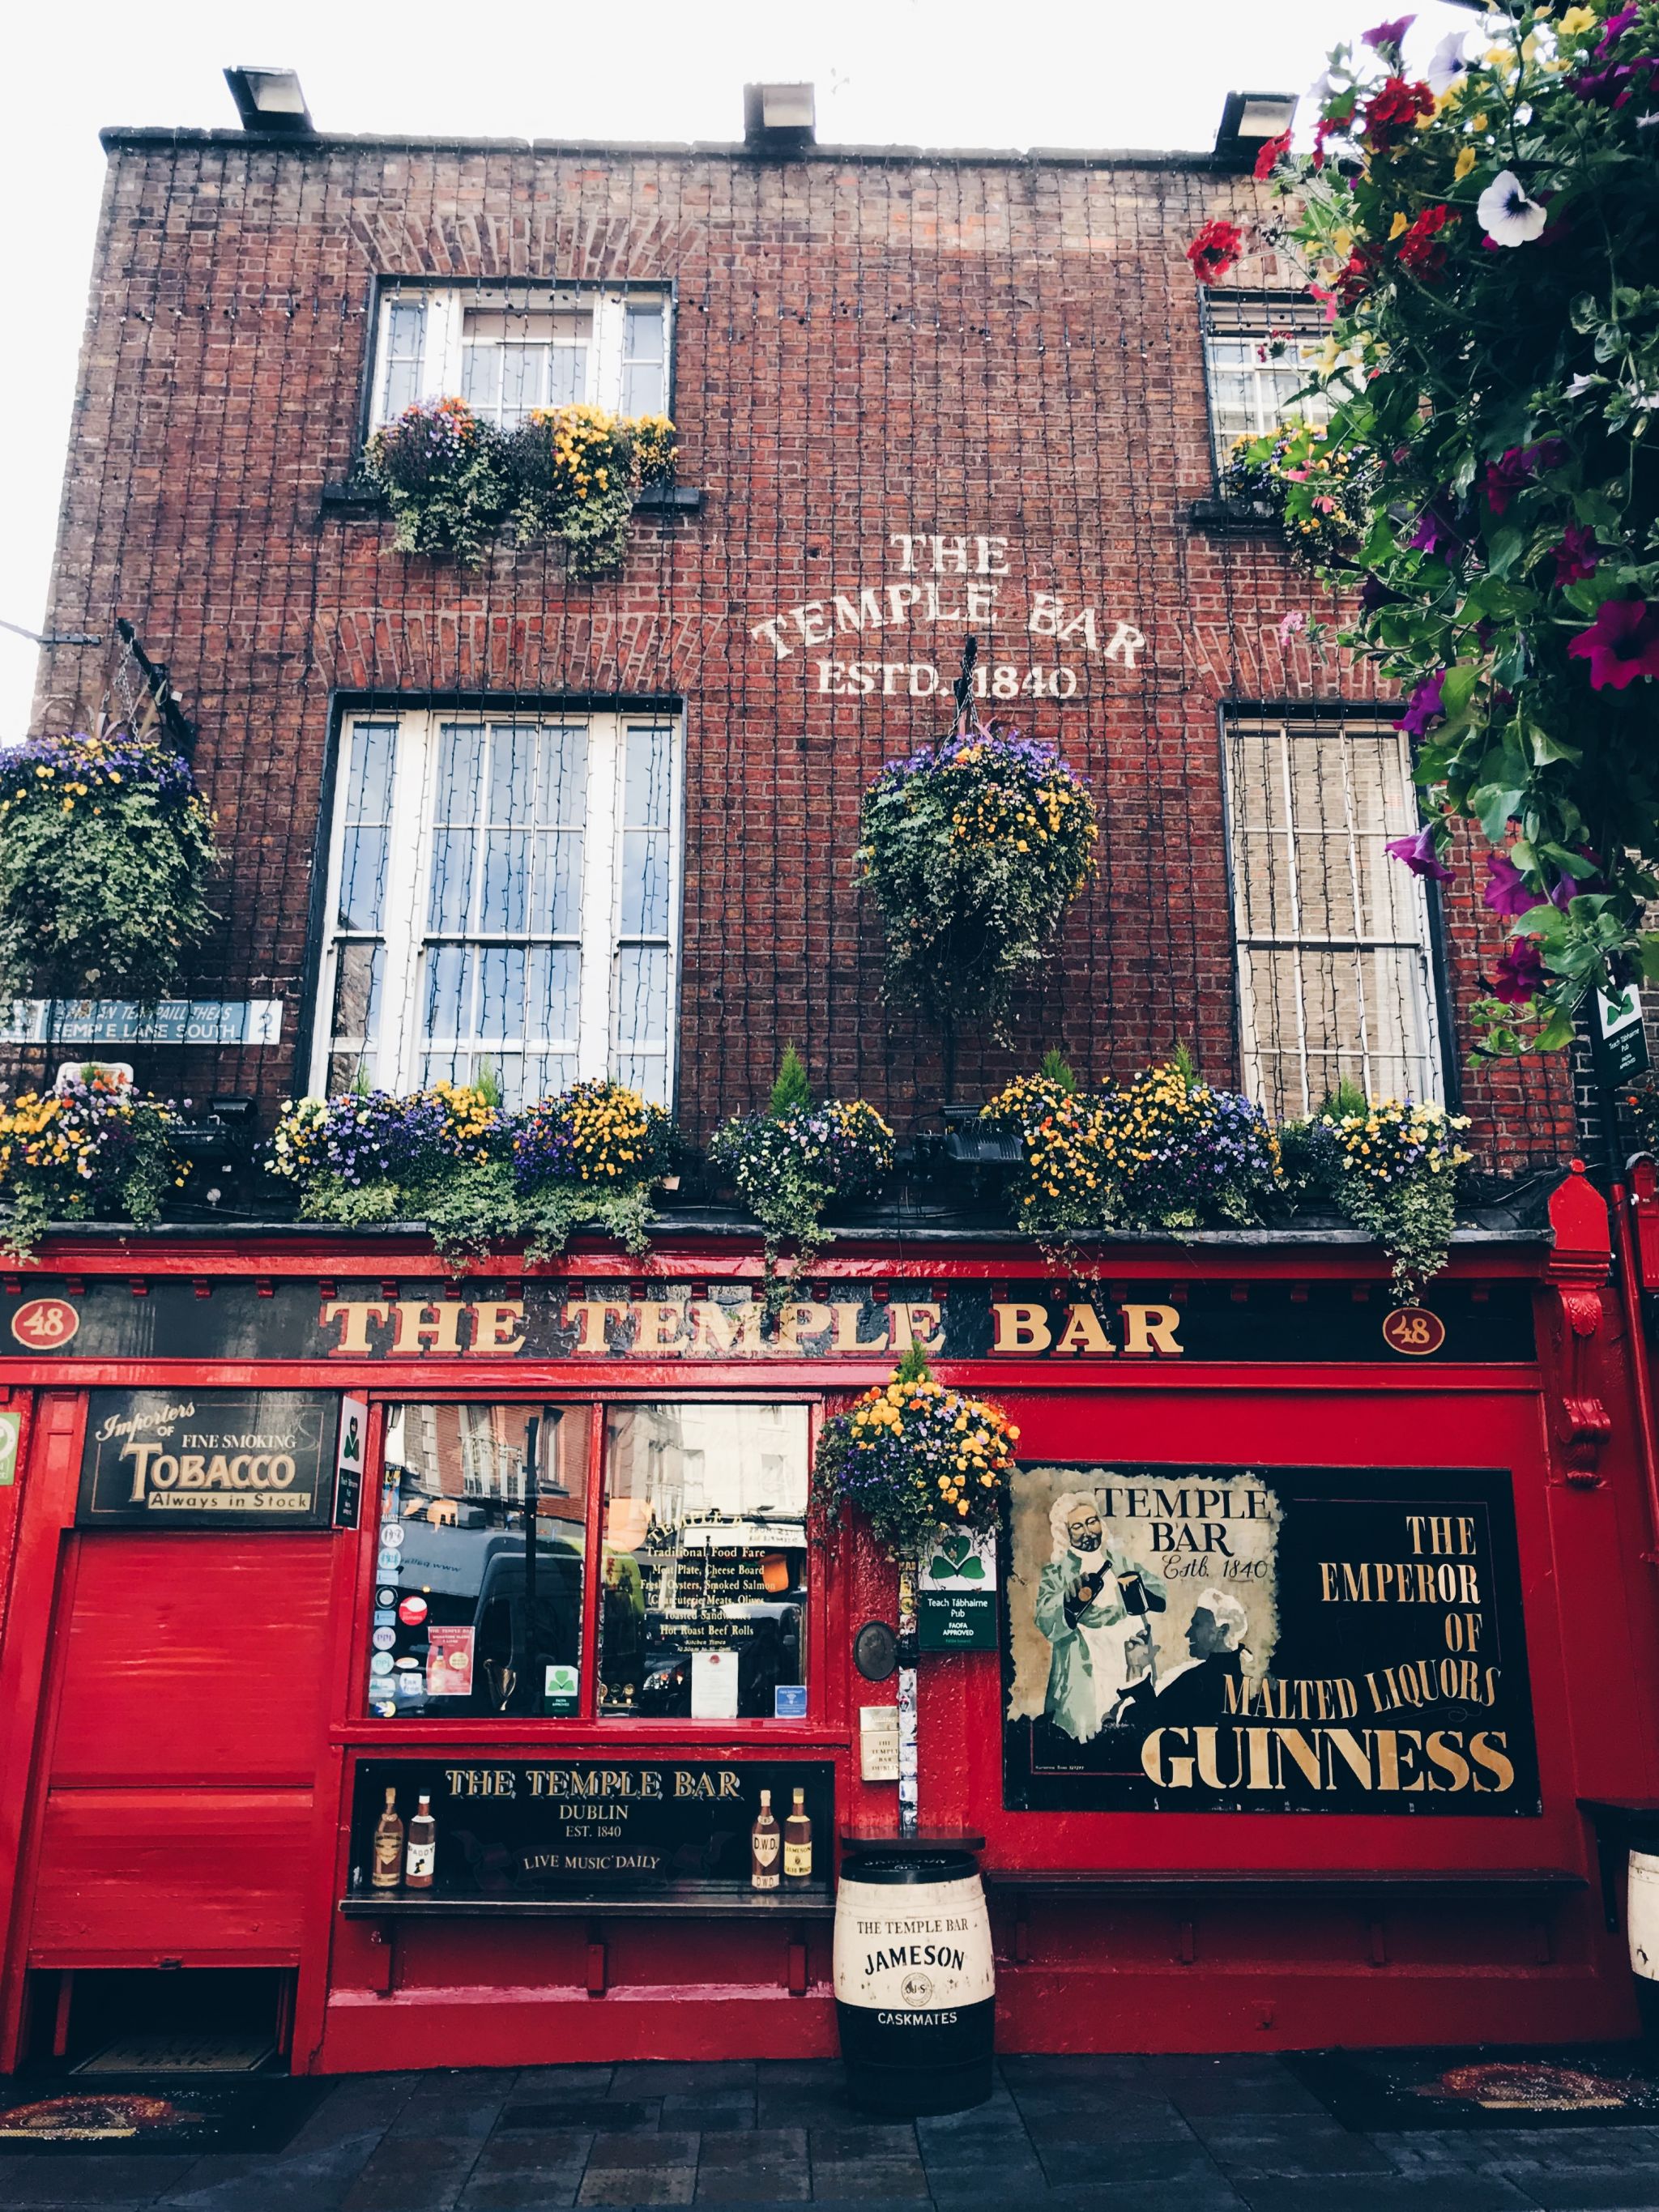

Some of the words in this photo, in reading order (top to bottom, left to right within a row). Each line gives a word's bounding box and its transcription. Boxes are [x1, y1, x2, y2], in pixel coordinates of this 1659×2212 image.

[890, 534, 1009, 574] THE
[750, 582, 998, 660] TEMPLE
[1027, 592, 1147, 669] BAR
[815, 659, 950, 697] ESTD.
[973, 664, 1078, 700] 1840
[123, 1024, 168, 1038] LANE
[177, 1024, 235, 1038] SOUTH
[258, 1012, 273, 1033] 2
[23, 1306, 64, 1336] 48
[322, 1301, 527, 1355] THE
[565, 1301, 946, 1353] TEMPLE
[991, 1302, 1184, 1354] BAR
[1392, 1315, 1431, 1345] 48
[95, 1401, 196, 1442] Importers
[157, 1426, 174, 1437] OF
[181, 1434, 220, 1448] FINE
[222, 1434, 297, 1449] SMOKING
[119, 1442, 296, 1502] TOBACCO
[151, 1493, 218, 1509] Always
[229, 1493, 244, 1507] in
[254, 1493, 308, 1508] Stock
[1094, 1487, 1271, 1519] TEMPLE
[1149, 1523, 1235, 1558] BAR
[1406, 1516, 1477, 1555] THE
[646, 1546, 706, 1557] Traditional
[711, 1546, 737, 1557] Food
[742, 1546, 766, 1557] Fare
[677, 1564, 702, 1576] Plate,
[706, 1564, 736, 1575] Cheese
[739, 1564, 765, 1575] Board
[1223, 1560, 1268, 1579] 1840
[667, 1579, 702, 1592] Oysters,
[705, 1579, 740, 1590] Smoked
[743, 1579, 775, 1590] Salmon
[1318, 1562, 1481, 1604] EMPEROR
[928, 1598, 949, 1608] Teach
[952, 1597, 988, 1608] Tábhairne
[951, 1609, 965, 1617] Pub
[665, 1610, 698, 1620] Toasted
[660, 1625, 676, 1635] Hot
[680, 1625, 705, 1635] Roast
[708, 1625, 727, 1635] Beef
[731, 1625, 754, 1635] Rolls
[1445, 1613, 1482, 1652] OF
[1221, 1673, 1358, 1720] MALTED
[1363, 1658, 1502, 1713] LIQUORS
[1141, 1726, 1515, 1792] GUINNESS
[446, 1770, 515, 1798] THE
[525, 1770, 663, 1799] TEMPLE
[673, 1771, 742, 1799] BAR
[559, 1805, 629, 1820] DUBLIN
[565, 1826, 592, 1838] EST.
[598, 1826, 621, 1837] 1840
[523, 1855, 560, 1871] LIVE
[565, 1856, 611, 1869] MUSIC
[616, 1856, 661, 1869] DAILY
[857, 1921, 881, 1934] THE
[885, 1920, 942, 1934] TEMPLE
[946, 1918, 969, 1931] BAR
[864, 1945, 965, 1975] JAMESON
[878, 2012, 957, 2026] CASKMATES
